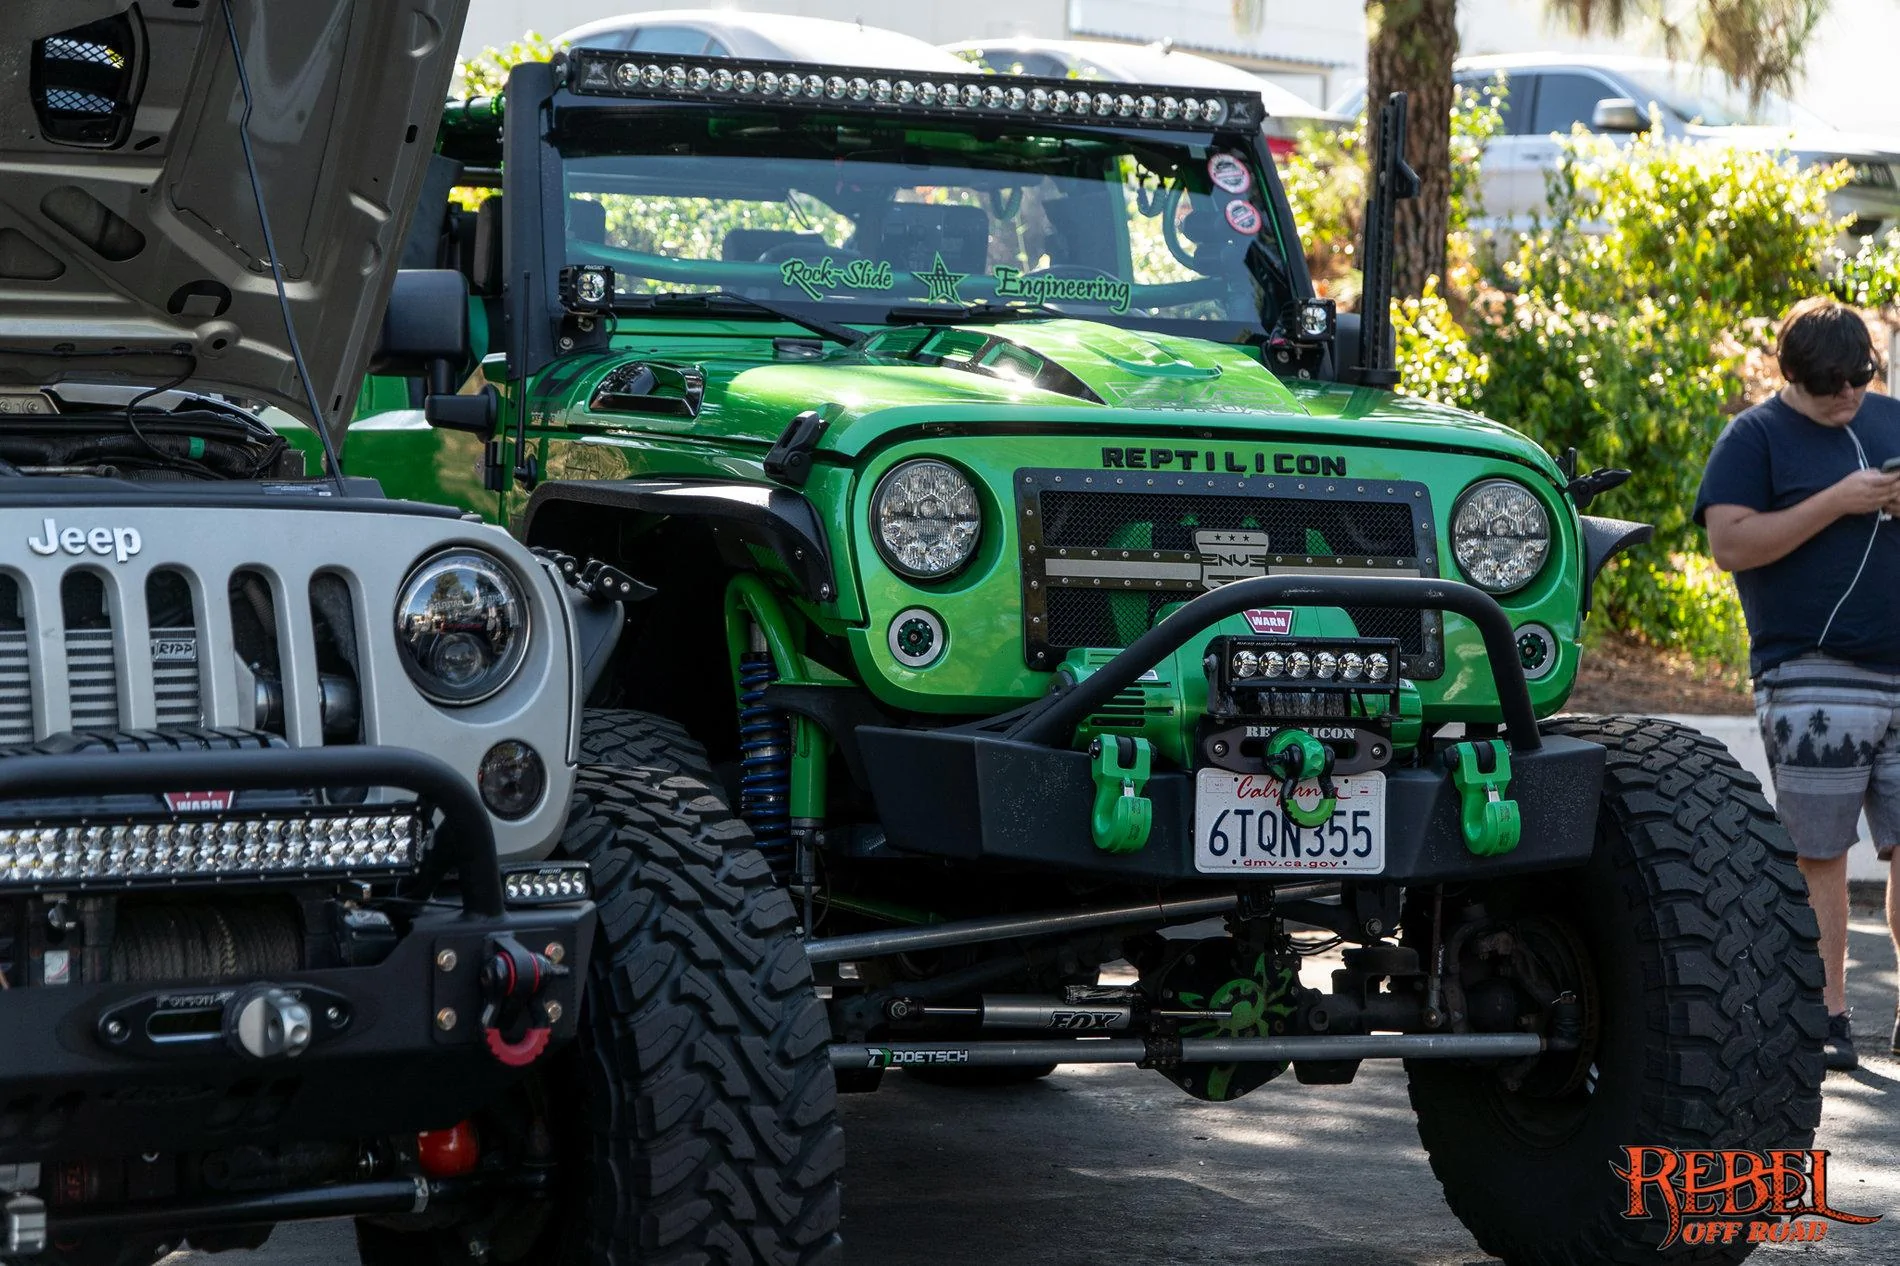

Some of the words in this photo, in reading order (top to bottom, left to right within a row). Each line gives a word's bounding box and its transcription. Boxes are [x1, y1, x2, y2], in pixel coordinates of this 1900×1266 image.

[780, 256, 893, 300] Rock-Slide
[995, 265, 1132, 314] Engineering
[1101, 447, 1347, 477] REPTILICON
[28, 518, 142, 563] Jeep
[1251, 616, 1287, 627] WARN
[159, 643, 193, 655] RIPP
[176, 800, 223, 811] WARN
[1208, 809, 1373, 858] 6TQN355
[1243, 858, 1339, 868] dmv.ca.gov
[1050, 1012, 1122, 1029] FOX
[892, 1050, 969, 1063] DOETSCH
